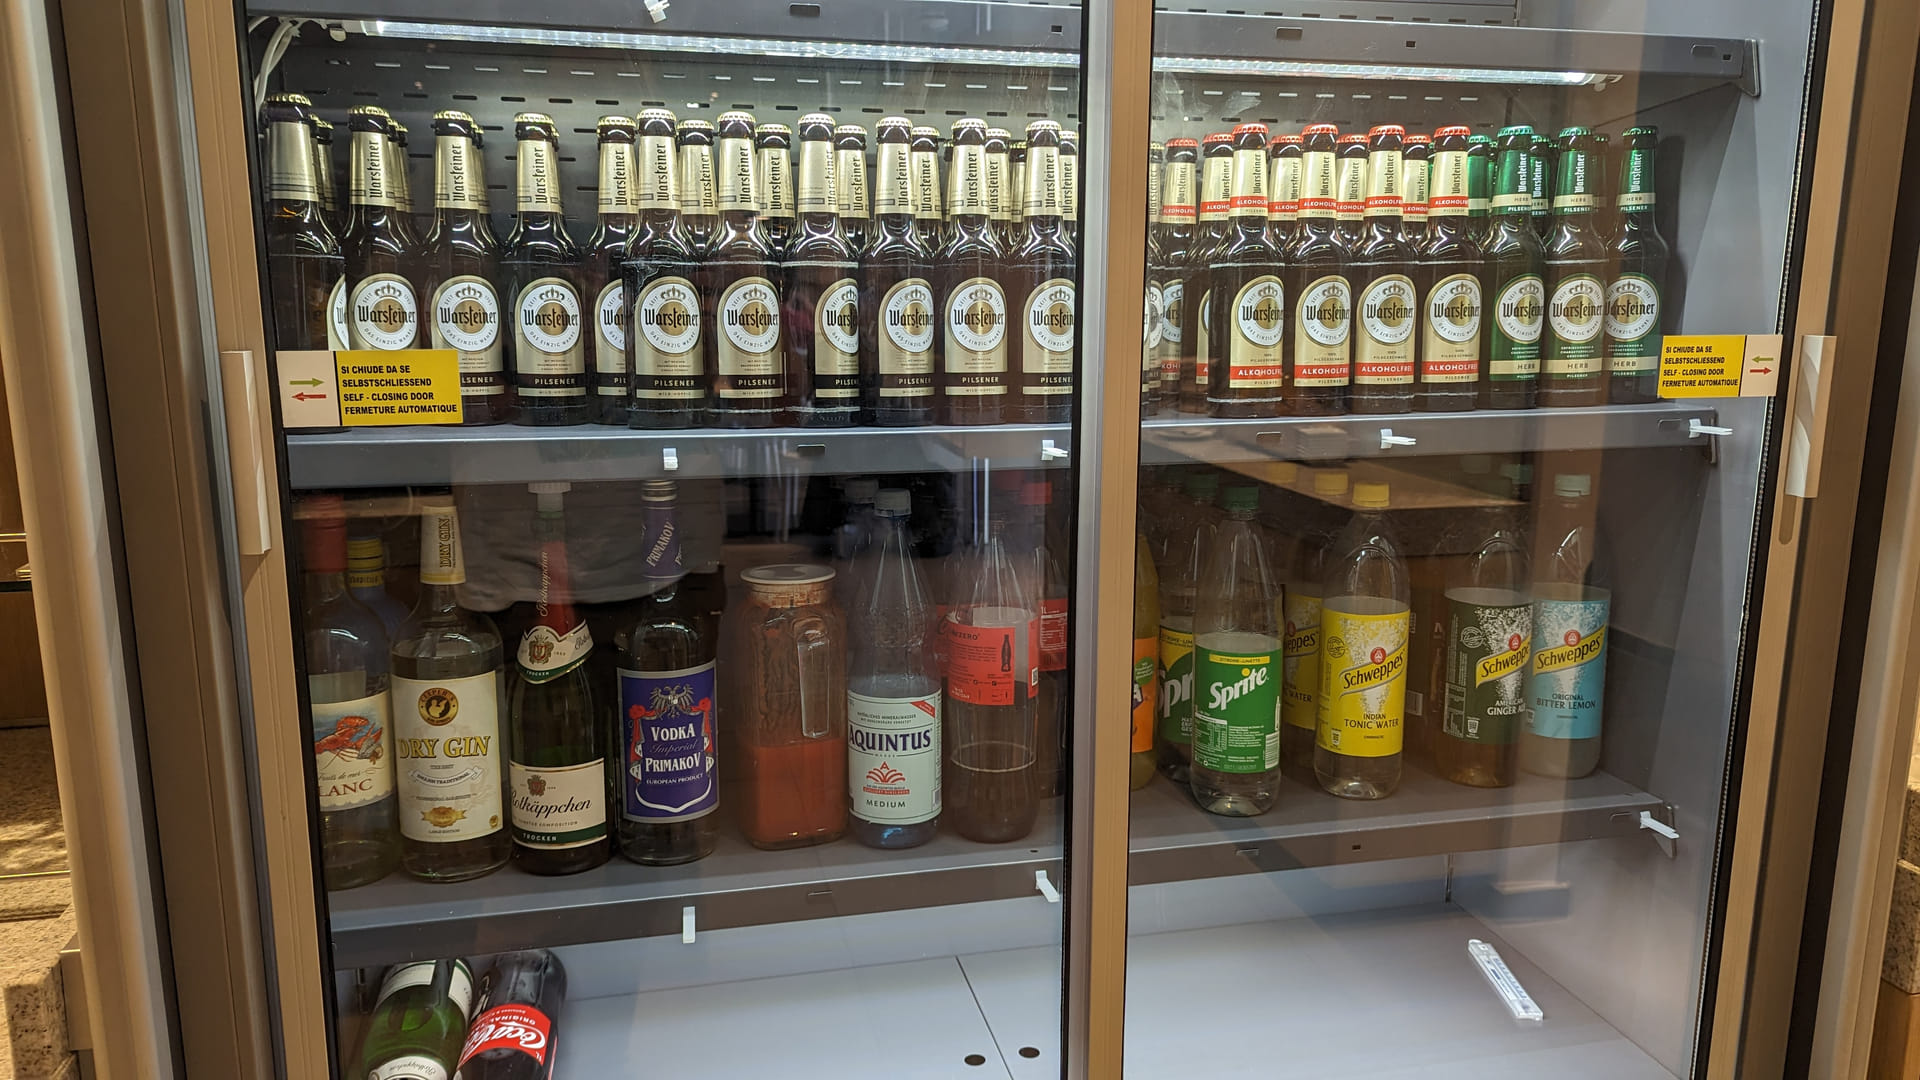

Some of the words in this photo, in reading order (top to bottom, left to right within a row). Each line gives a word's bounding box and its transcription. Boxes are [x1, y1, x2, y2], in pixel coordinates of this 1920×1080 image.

[367, 140, 382, 199] Warsteiner
[449, 144, 465, 202] Warsteiner
[532, 147, 547, 204] Warsteiner
[612, 150, 627, 206] Warsteiner
[654, 144, 669, 201] Warsteiner
[701, 152, 713, 208] Warsteiner
[738, 146, 750, 204] Warsteiner
[824, 150, 836, 206] Warsteiner
[896, 150, 908, 207] Warsteiner
[966, 152, 979, 208] Warsteiner
[1221, 160, 1230, 199] Warsteiner
[1252, 153, 1262, 195] Warsteiner
[1290, 161, 1300, 199] Warsteiner
[1320, 156, 1330, 196] Warsteiner
[1349, 160, 1359, 200] Warsteiner
[1384, 154, 1394, 194] Warsteiner
[1452, 154, 1462, 194] Warsteiner
[1517, 152, 1528, 193] Warsteiner
[1532, 160, 1542, 198] Warsteiner
[1574, 153, 1585, 194] Warsteiner
[1630, 152, 1642, 193] Warsteiner
[768, 156, 781, 210] Warsteiner
[851, 158, 863, 212] Warsteiner
[919, 158, 932, 212] Warsteiner
[988, 160, 999, 213] Warsteiner
[1043, 153, 1056, 209] Warsteiner
[1062, 161, 1072, 214] Warsteiner
[1176, 166, 1187, 204] Warsteiner
[1416, 164, 1426, 202] Warsteiner
[358, 304, 416, 326] Warsteiner
[440, 306, 497, 327] Warsteiner
[524, 308, 578, 329] Warsteiner
[644, 308, 699, 328] Warsteiner
[727, 309, 779, 328] Warsteiner
[890, 309, 934, 328] Warsteiner
[954, 308, 1004, 328] Warsteiner
[1306, 304, 1350, 322] Warsteiner
[1367, 303, 1413, 320] Warsteiner
[1434, 302, 1480, 320] Warsteiner
[1552, 299, 1602, 318] Warsteiner
[1664, 356, 1725, 364] SELBSTSCHLIESSEND
[1665, 346, 1672, 354] SI
[1673, 346, 1695, 354] CHIUDE
[340, 366, 348, 374] SI
[352, 365, 384, 374] CHIUDE
[386, 365, 398, 374] DA
[400, 365, 410, 373] SE
[1567, 362, 1589, 370] HERB
[1613, 360, 1637, 368] HERB
[1682, 368, 1707, 376] CLOSING
[1708, 368, 1724, 376] DOOR
[342, 378, 432, 388] SELBSTSCHLIESSEND
[534, 377, 576, 385] PILSENER
[654, 379, 695, 387] PILSENER
[962, 376, 1000, 384] PILSENER
[1698, 379, 1738, 387] AUTOMATIQUE
[344, 392, 364, 402] SELF
[371, 392, 408, 402] CLOSING
[410, 392, 434, 401] DOOR
[345, 406, 396, 415] FERMETURE
[398, 404, 458, 414] AUTOMATIQUE
[438, 518, 452, 541] GIN
[440, 542, 452, 568] DRY
[646, 521, 675, 568] PRIMAKOV
[958, 632, 978, 640] ZERO
[1536, 637, 1601, 670] Schweppes
[1343, 654, 1403, 690] Schweppes
[1208, 666, 1267, 711] Sprite
[1552, 693, 1584, 701] ORIGINAL
[1487, 706, 1514, 718] GINGER
[1536, 697, 1565, 708] BITTER
[1568, 700, 1597, 710] LEMON
[1344, 718, 1373, 730] TONIC
[1374, 718, 1399, 730] WATER
[1364, 713, 1386, 721] INDIAN
[650, 724, 696, 742] VODKA
[849, 724, 931, 752] AQUINTUS
[444, 736, 490, 758] GIN
[650, 740, 699, 755] Imperial
[644, 752, 702, 773] PRIMAKOV
[646, 777, 677, 786] EUROPEAN
[678, 773, 704, 784] PRODUCT
[866, 799, 906, 809] MEDIUM
[522, 832, 557, 842] TROCKEN
